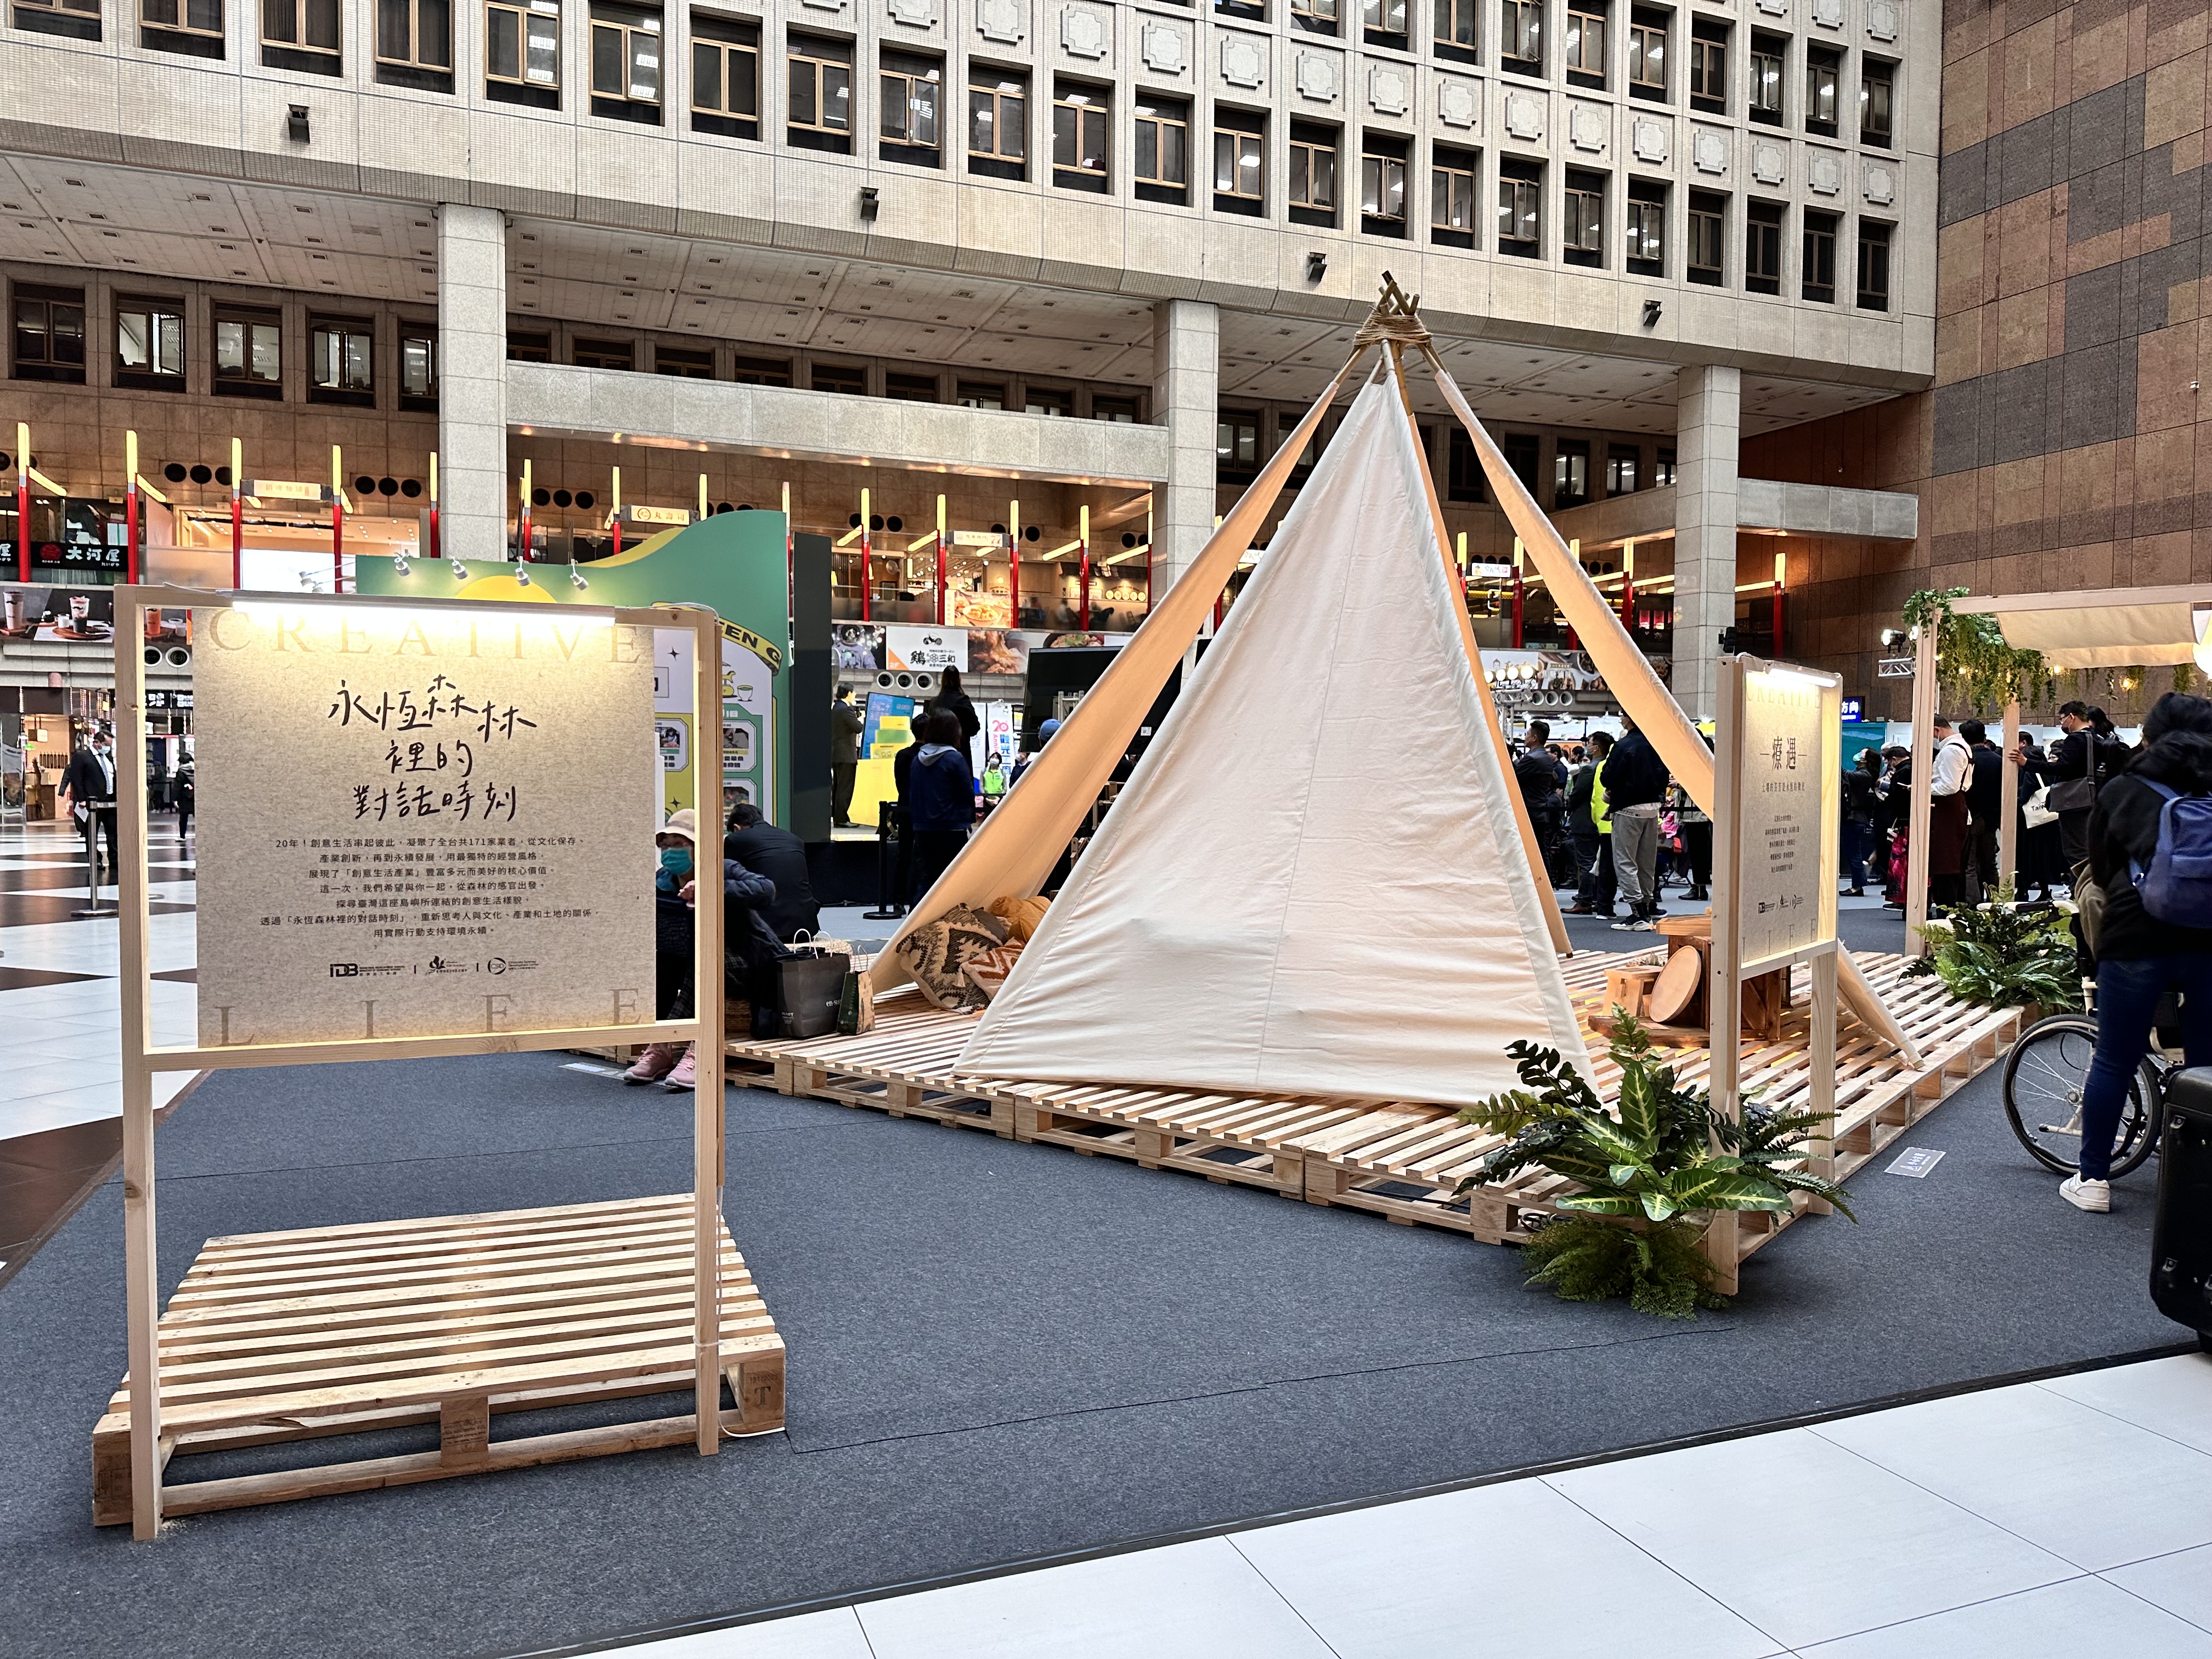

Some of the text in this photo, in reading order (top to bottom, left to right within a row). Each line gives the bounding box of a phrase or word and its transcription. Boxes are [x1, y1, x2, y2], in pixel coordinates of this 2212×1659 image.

[66, 546, 120, 562] 大河屋
[208, 608, 640, 664] CREATIVE
[328, 674, 537, 743] 永恆森林
[385, 740, 472, 777] 裡的
[353, 781, 515, 821] 對話時刻
[215, 988, 641, 1046] LIFE
[754, 1386, 771, 1405] T
